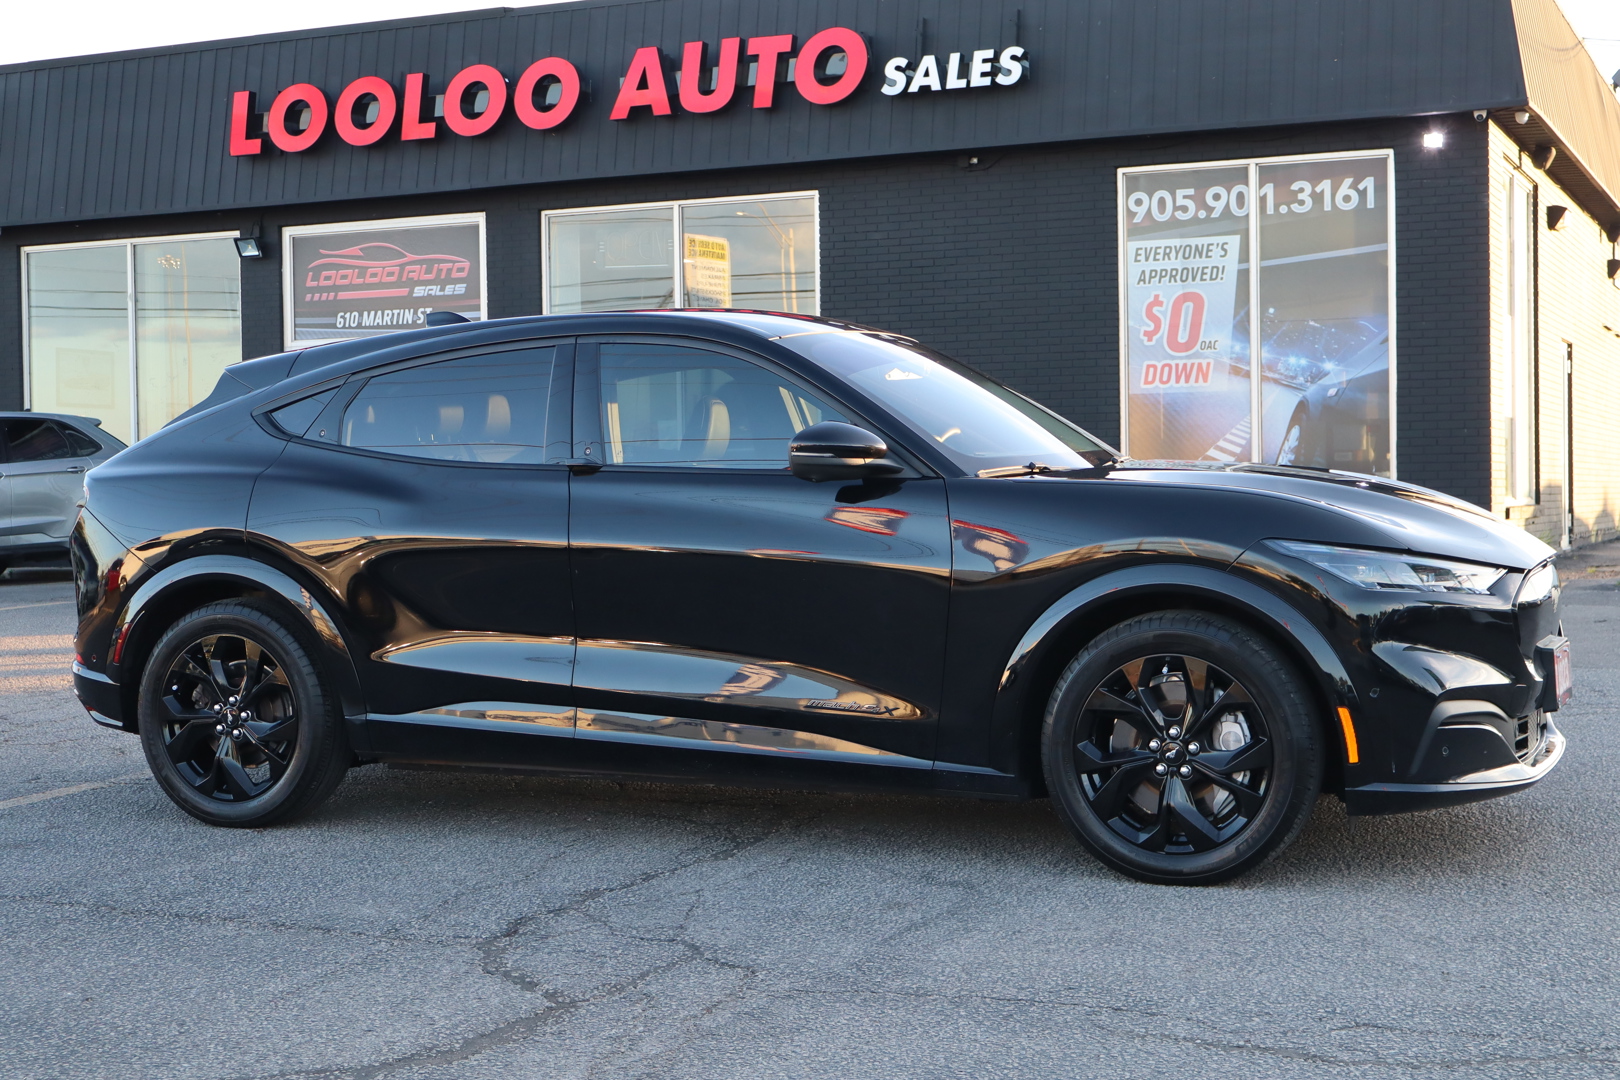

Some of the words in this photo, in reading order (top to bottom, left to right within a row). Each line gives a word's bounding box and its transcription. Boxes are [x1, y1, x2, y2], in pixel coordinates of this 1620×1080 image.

[229, 56, 582, 157] LOOLOO
[610, 26, 868, 120] AUTO
[880, 45, 1026, 97] SALES
[1127, 176, 1375, 223] 905.901.3161
[1133, 242, 1229, 263] EVERYONE'S
[305, 267, 401, 287] LOOLOO
[402, 262, 470, 282] AUTO
[1136, 265, 1226, 285] APPROVED!
[412, 283, 468, 298] SALES
[336, 311, 359, 328] 610
[361, 308, 414, 327] MARTIN
[1142, 291, 1206, 353] $0
[1200, 339, 1219, 351] OAC
[1142, 361, 1212, 386] DOWN
